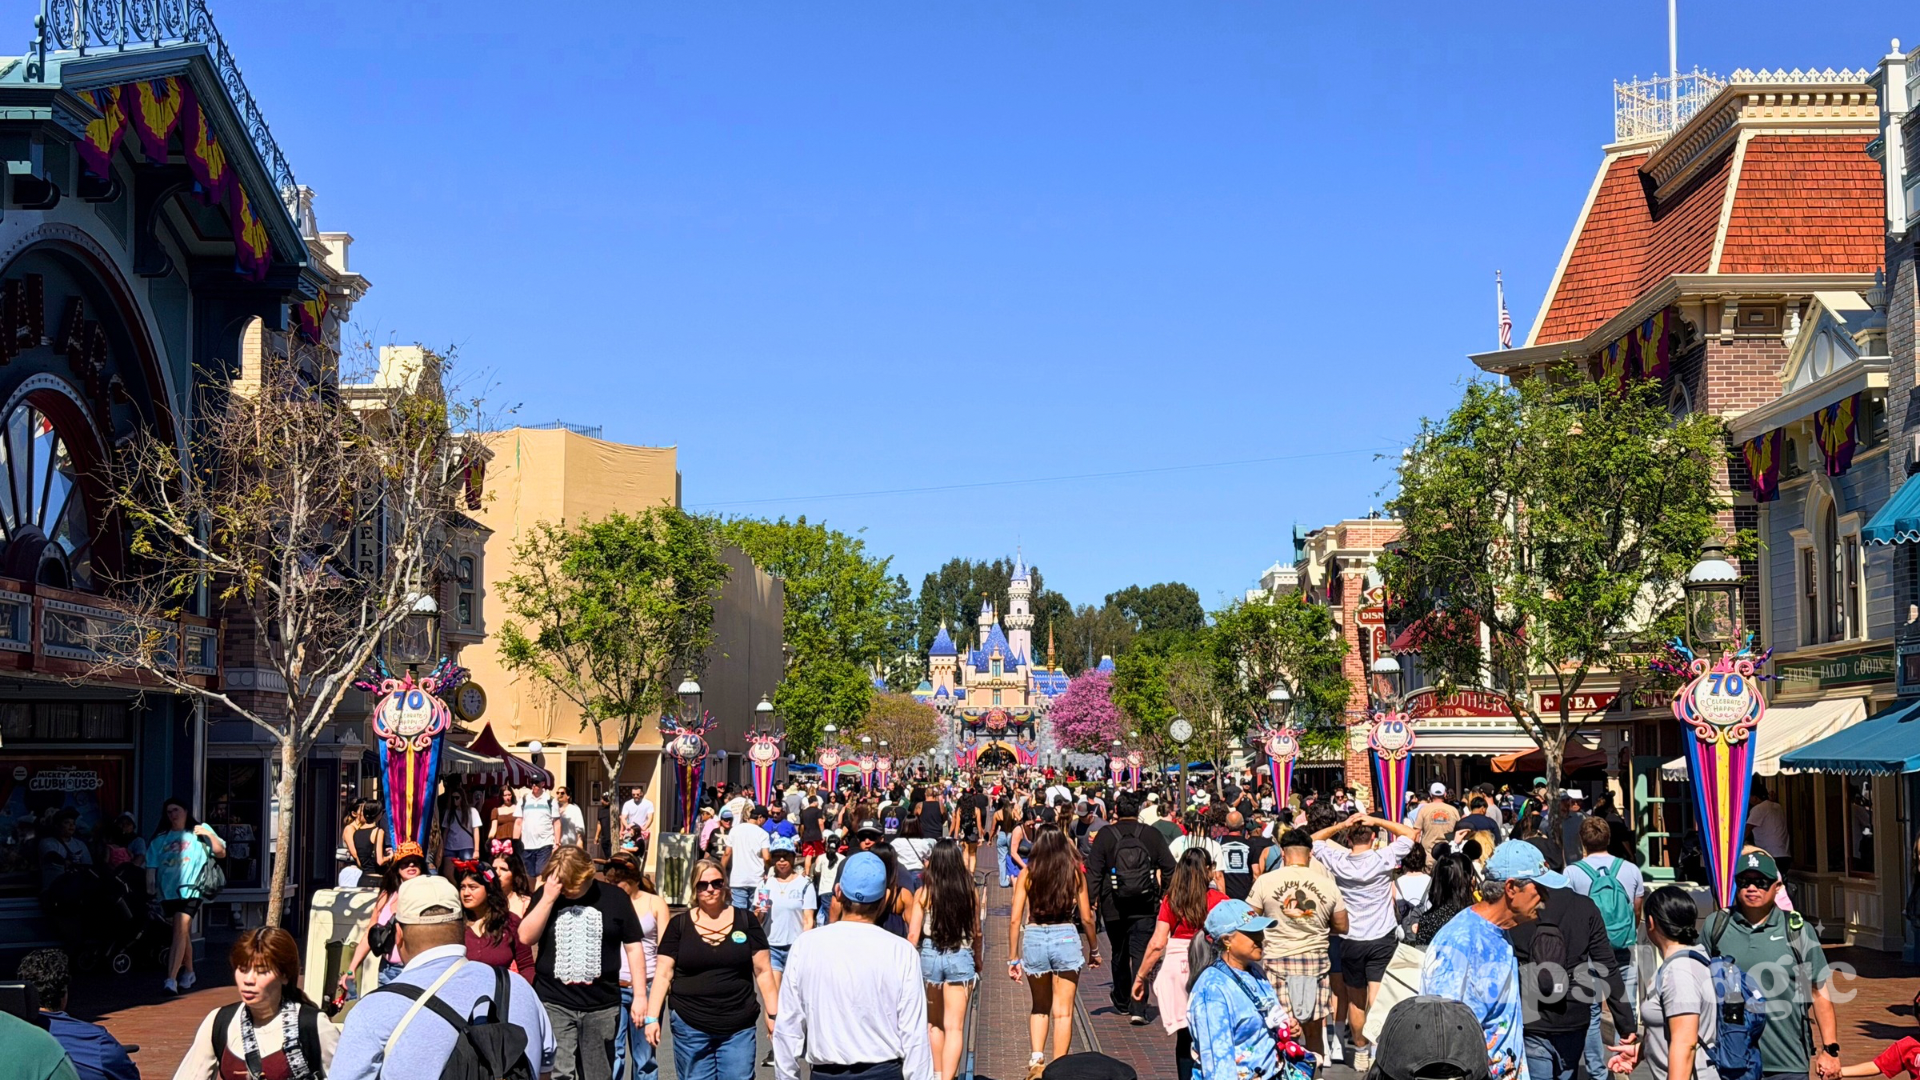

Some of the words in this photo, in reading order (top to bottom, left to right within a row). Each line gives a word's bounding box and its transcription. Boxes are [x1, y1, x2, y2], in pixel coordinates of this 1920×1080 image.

[1361, 611, 1385, 620] DISN
[1788, 667, 1813, 682] FRESH
[1820, 662, 1848, 679] BAKED
[1853, 658, 1884, 677] GOODS
[1708, 673, 1744, 697] 70
[393, 690, 424, 711] 70
[1383, 721, 1404, 734] 70
[682, 734, 699, 746] 70
[757, 742, 770, 751] 70
[1276, 735, 1291, 745] 70
[884, 817, 899, 829] 70
[1748, 854, 1759, 867] LA
[1271, 880, 1300, 902] Mickey
[1301, 880, 1328, 905] Mouse
